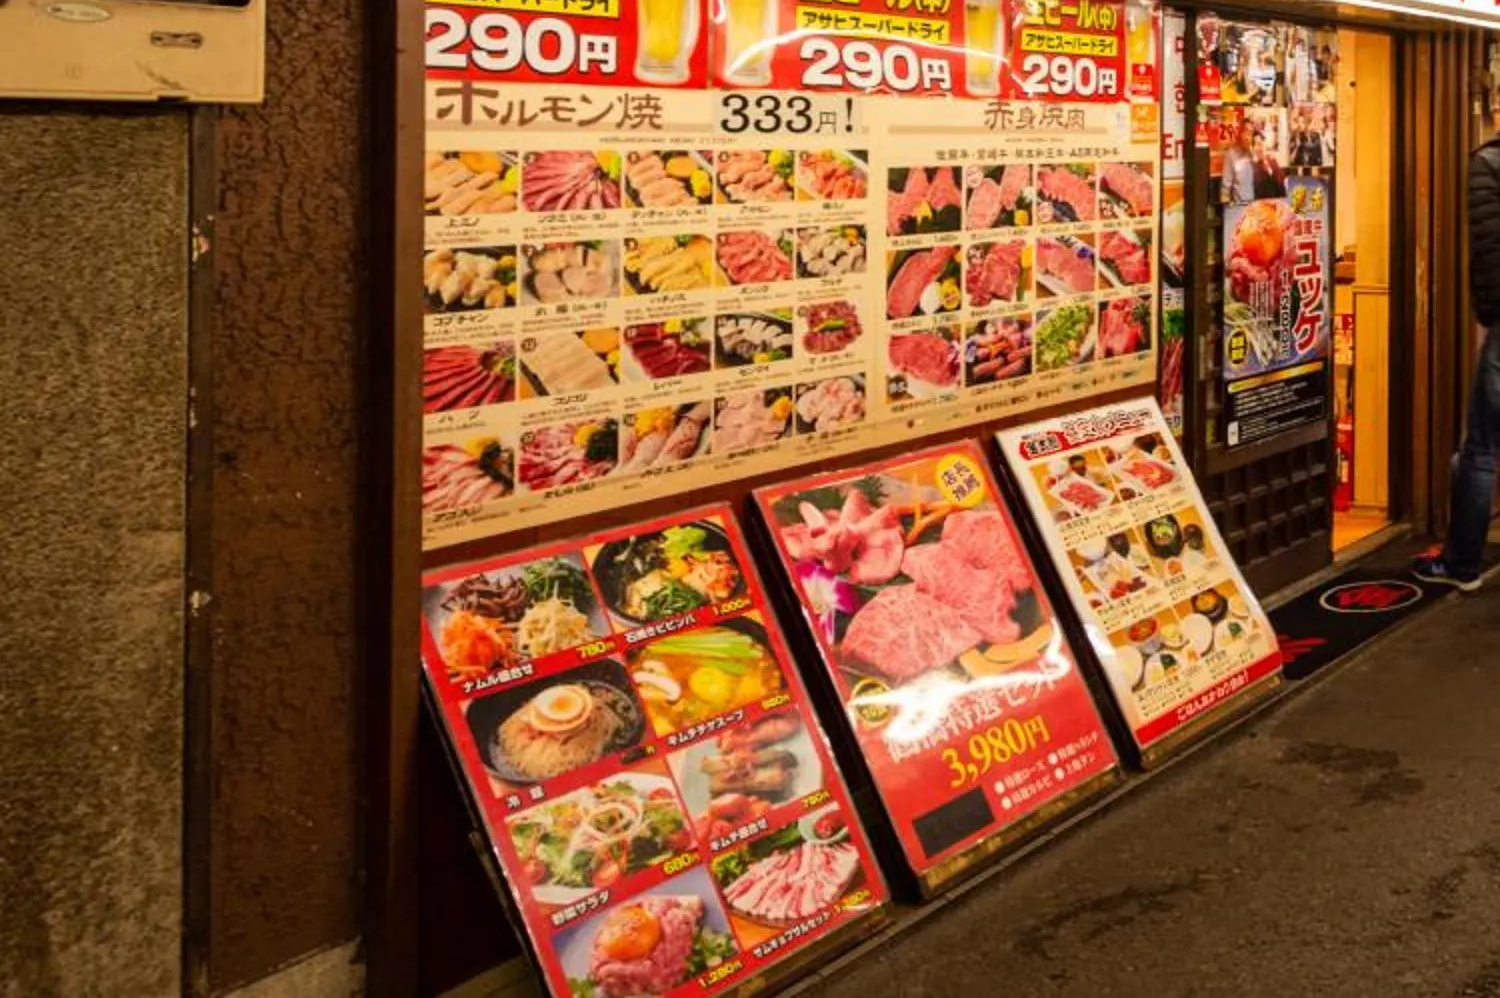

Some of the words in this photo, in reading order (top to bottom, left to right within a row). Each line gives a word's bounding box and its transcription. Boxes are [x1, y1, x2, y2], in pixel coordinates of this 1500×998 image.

[425, 9, 617, 73] 290円
[803, 10, 944, 39] アサヒスーパードライ
[801, 38, 951, 91] 290円
[1023, 55, 1117, 96] 290円
[435, 82, 662, 130] ホルモン焼
[1294, 240, 1323, 352] ユッケ
[942, 715, 1049, 787] 3,980円
